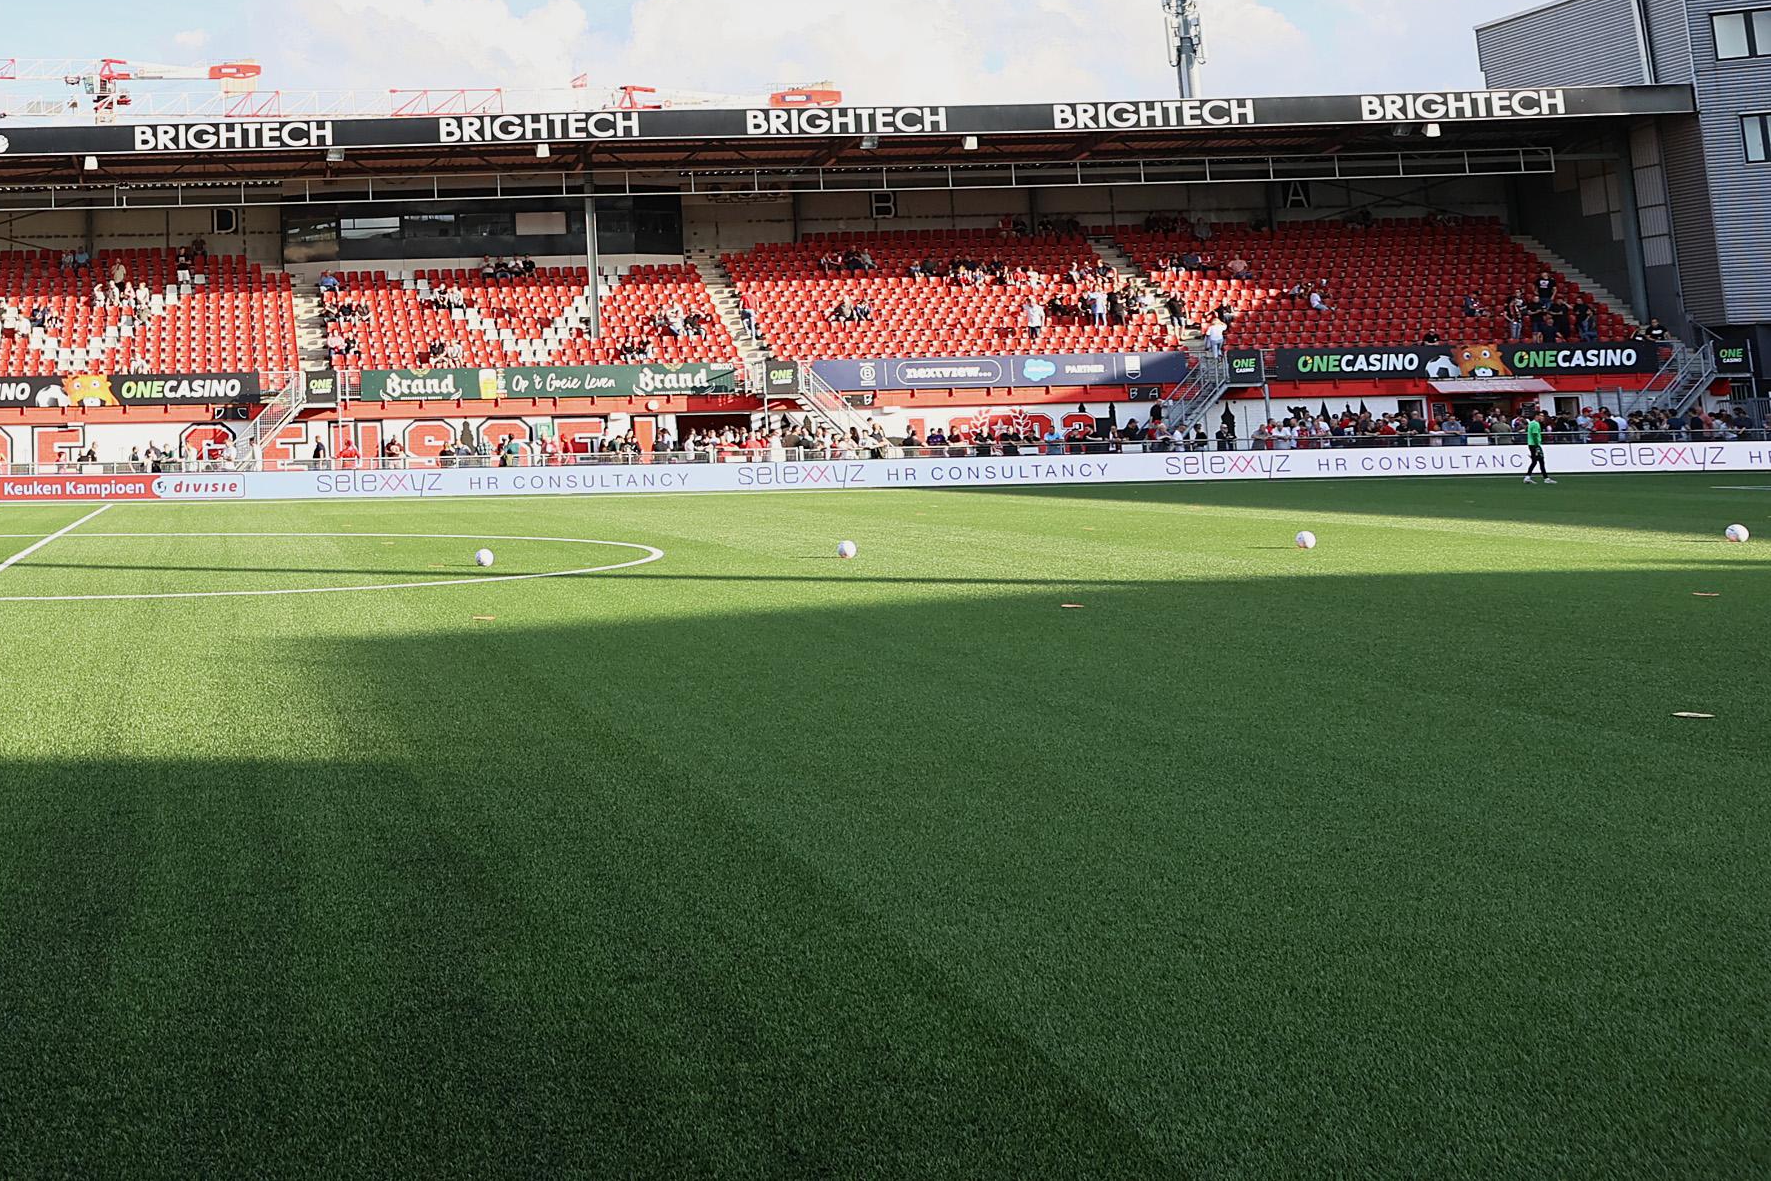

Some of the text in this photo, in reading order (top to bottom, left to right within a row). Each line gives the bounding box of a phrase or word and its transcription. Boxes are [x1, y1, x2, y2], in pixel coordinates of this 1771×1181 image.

[1053, 99, 1255, 129] BRIGHTECH
[1360, 89, 1566, 121] BRIGHTECH
[439, 112, 639, 142] BRIGHTECH
[746, 107, 947, 135] BRIGHTECH
[135, 121, 333, 151] BRIGHTECH
[872, 191, 895, 218] B
[1287, 181, 1308, 208] A
[214, 208, 236, 234] D
[1232, 358, 1256, 368] ONE
[1297, 354, 1419, 373] ONECASINO
[1513, 348, 1637, 369] ONECASINO
[1719, 348, 1743, 359] ONE
[309, 378, 333, 389] ONE
[386, 372, 456, 397] Brand
[512, 374, 530, 393] Op
[585, 372, 616, 389] Leven
[639, 369, 709, 391] Brand
[770, 369, 794, 379] ONE
[121, 379, 240, 399] ONECASINO
[887, 468, 916, 481] HR
[931, 463, 1109, 480] CONSULTANCY
[1318, 457, 1347, 471] HR
[1361, 453, 1530, 471] CONSULTANC
[3, 479, 237, 498] Keuken Kampioen divisie
[470, 476, 498, 489] HR
[513, 472, 690, 489] CONSULTANCY
